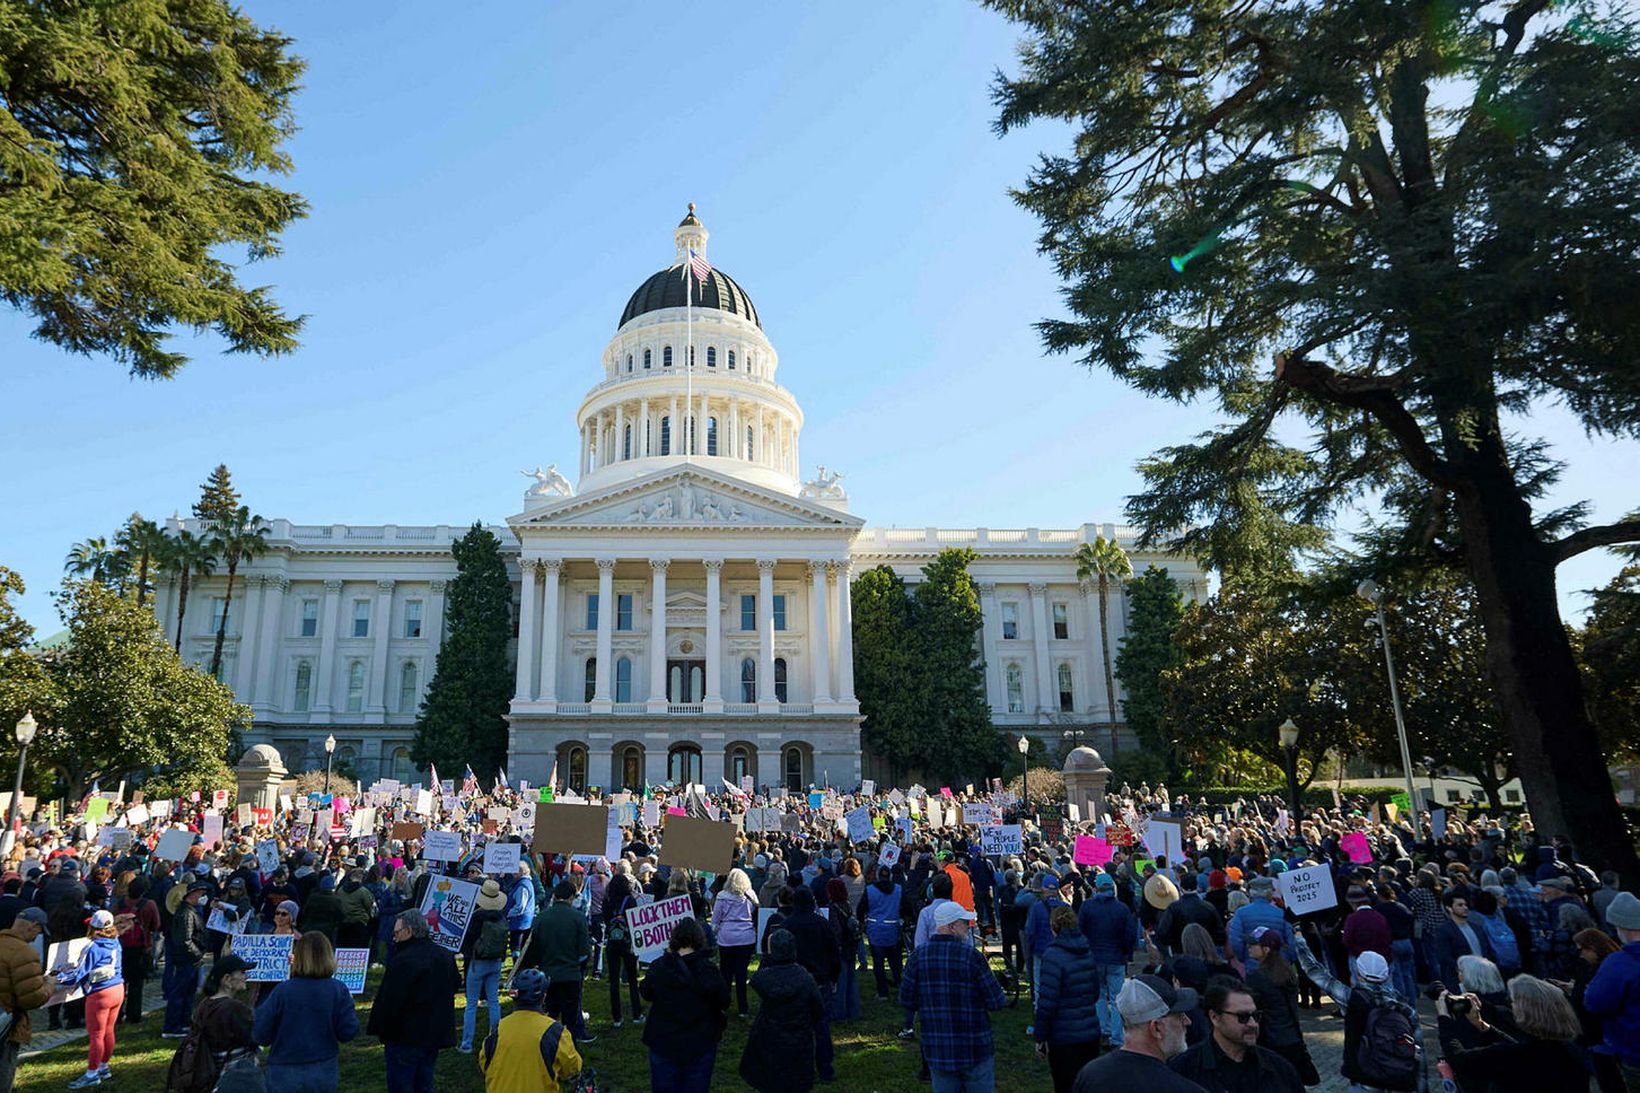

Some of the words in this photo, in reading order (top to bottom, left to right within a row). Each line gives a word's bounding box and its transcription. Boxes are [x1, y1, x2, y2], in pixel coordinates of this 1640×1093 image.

[982, 827, 994, 837] WE
[983, 843, 1003, 853] NEED
[1004, 841, 1020, 853] YOU!
[1293, 872, 1310, 883] NO
[1290, 881, 1320, 893] PROJECT
[447, 893, 462, 904] WE
[1296, 891, 1317, 902] 2025
[443, 901, 467, 915] ALL
[631, 905, 660, 928] LOCK
[659, 896, 692, 918] THEM
[447, 912, 465, 926] THIS
[643, 922, 672, 947] BOTH
[233, 935, 266, 947] PADILLA
[250, 948, 290, 957] DEMOCRACY
[339, 951, 366, 959] RESIST
